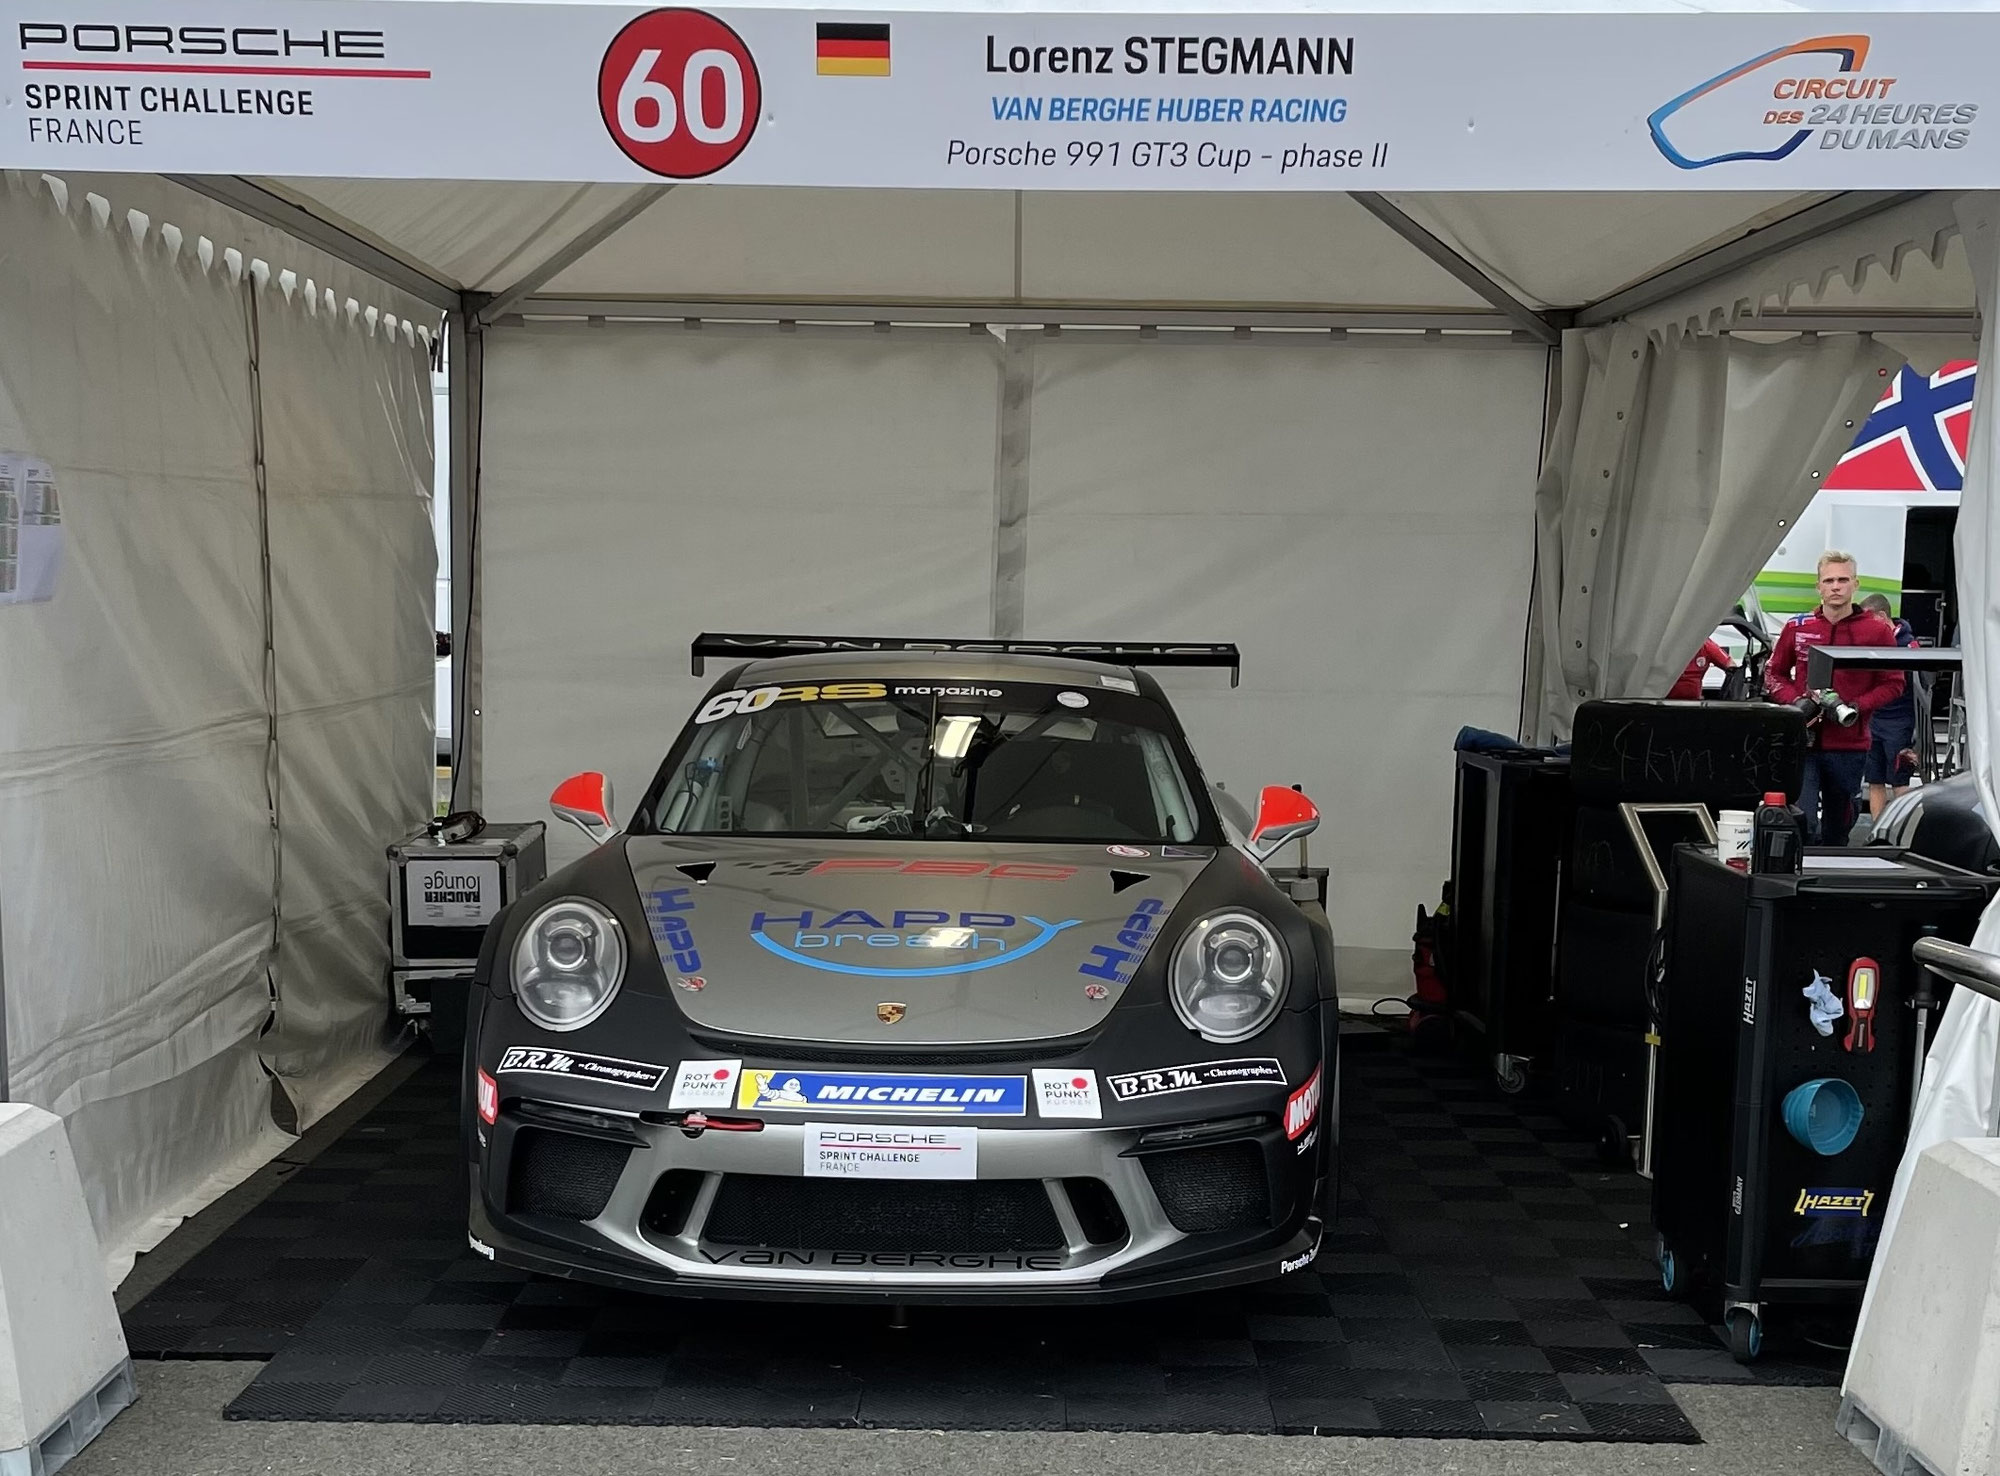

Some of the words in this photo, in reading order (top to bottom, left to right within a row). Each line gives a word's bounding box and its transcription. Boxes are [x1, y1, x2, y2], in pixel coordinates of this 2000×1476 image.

[19, 23, 385, 58] PORSCHE
[986, 35, 1113, 74] Lorenz
[1124, 36, 1354, 76] STEGMANN
[616, 49, 745, 146] 60
[1773, 78, 1897, 100] CIRCUIT
[25, 84, 131, 112] SPRINT
[141, 86, 314, 116] CHALLENGE
[991, 96, 1043, 121] VAN
[1048, 97, 1150, 122] BERGHE
[1156, 97, 1245, 123] HUBER
[1249, 98, 1348, 123] RACING
[1763, 110, 1803, 125] DES
[1807, 104, 1849, 126] 24
[1850, 103, 1979, 126] HEURES
[28, 117, 144, 146] FRANCE
[1820, 129, 1867, 150] DU
[1868, 129, 1971, 150] MANS
[947, 139, 1057, 168] Porsche
[1066, 141, 1121, 168] 991
[1131, 141, 1189, 169] GT3
[1198, 142, 1251, 174] Cup
[1281, 142, 1364, 174] phase
[895, 685, 1002, 698] magazine
[695, 686, 782, 724] 60
[424, 871, 481, 894] lounge
[794, 931, 1006, 951] breah
[1743, 976, 1756, 1025] HAZET
[682, 1081, 727, 1090] PUNKT
[685, 1073, 711, 1081] ROT
[1044, 1082, 1070, 1090] ROT
[816, 1085, 1006, 1103] MICHELIN
[1045, 1090, 1090, 1099] PUNKT
[820, 1131, 947, 1144] PORSCHE
[819, 1151, 856, 1161] SPRINT
[859, 1152, 920, 1163] CHALLENGE
[819, 1161, 860, 1173] FRANCE
[1802, 1193, 1867, 1210] HAZET
[831, 1252, 1062, 1271] BERGHE
